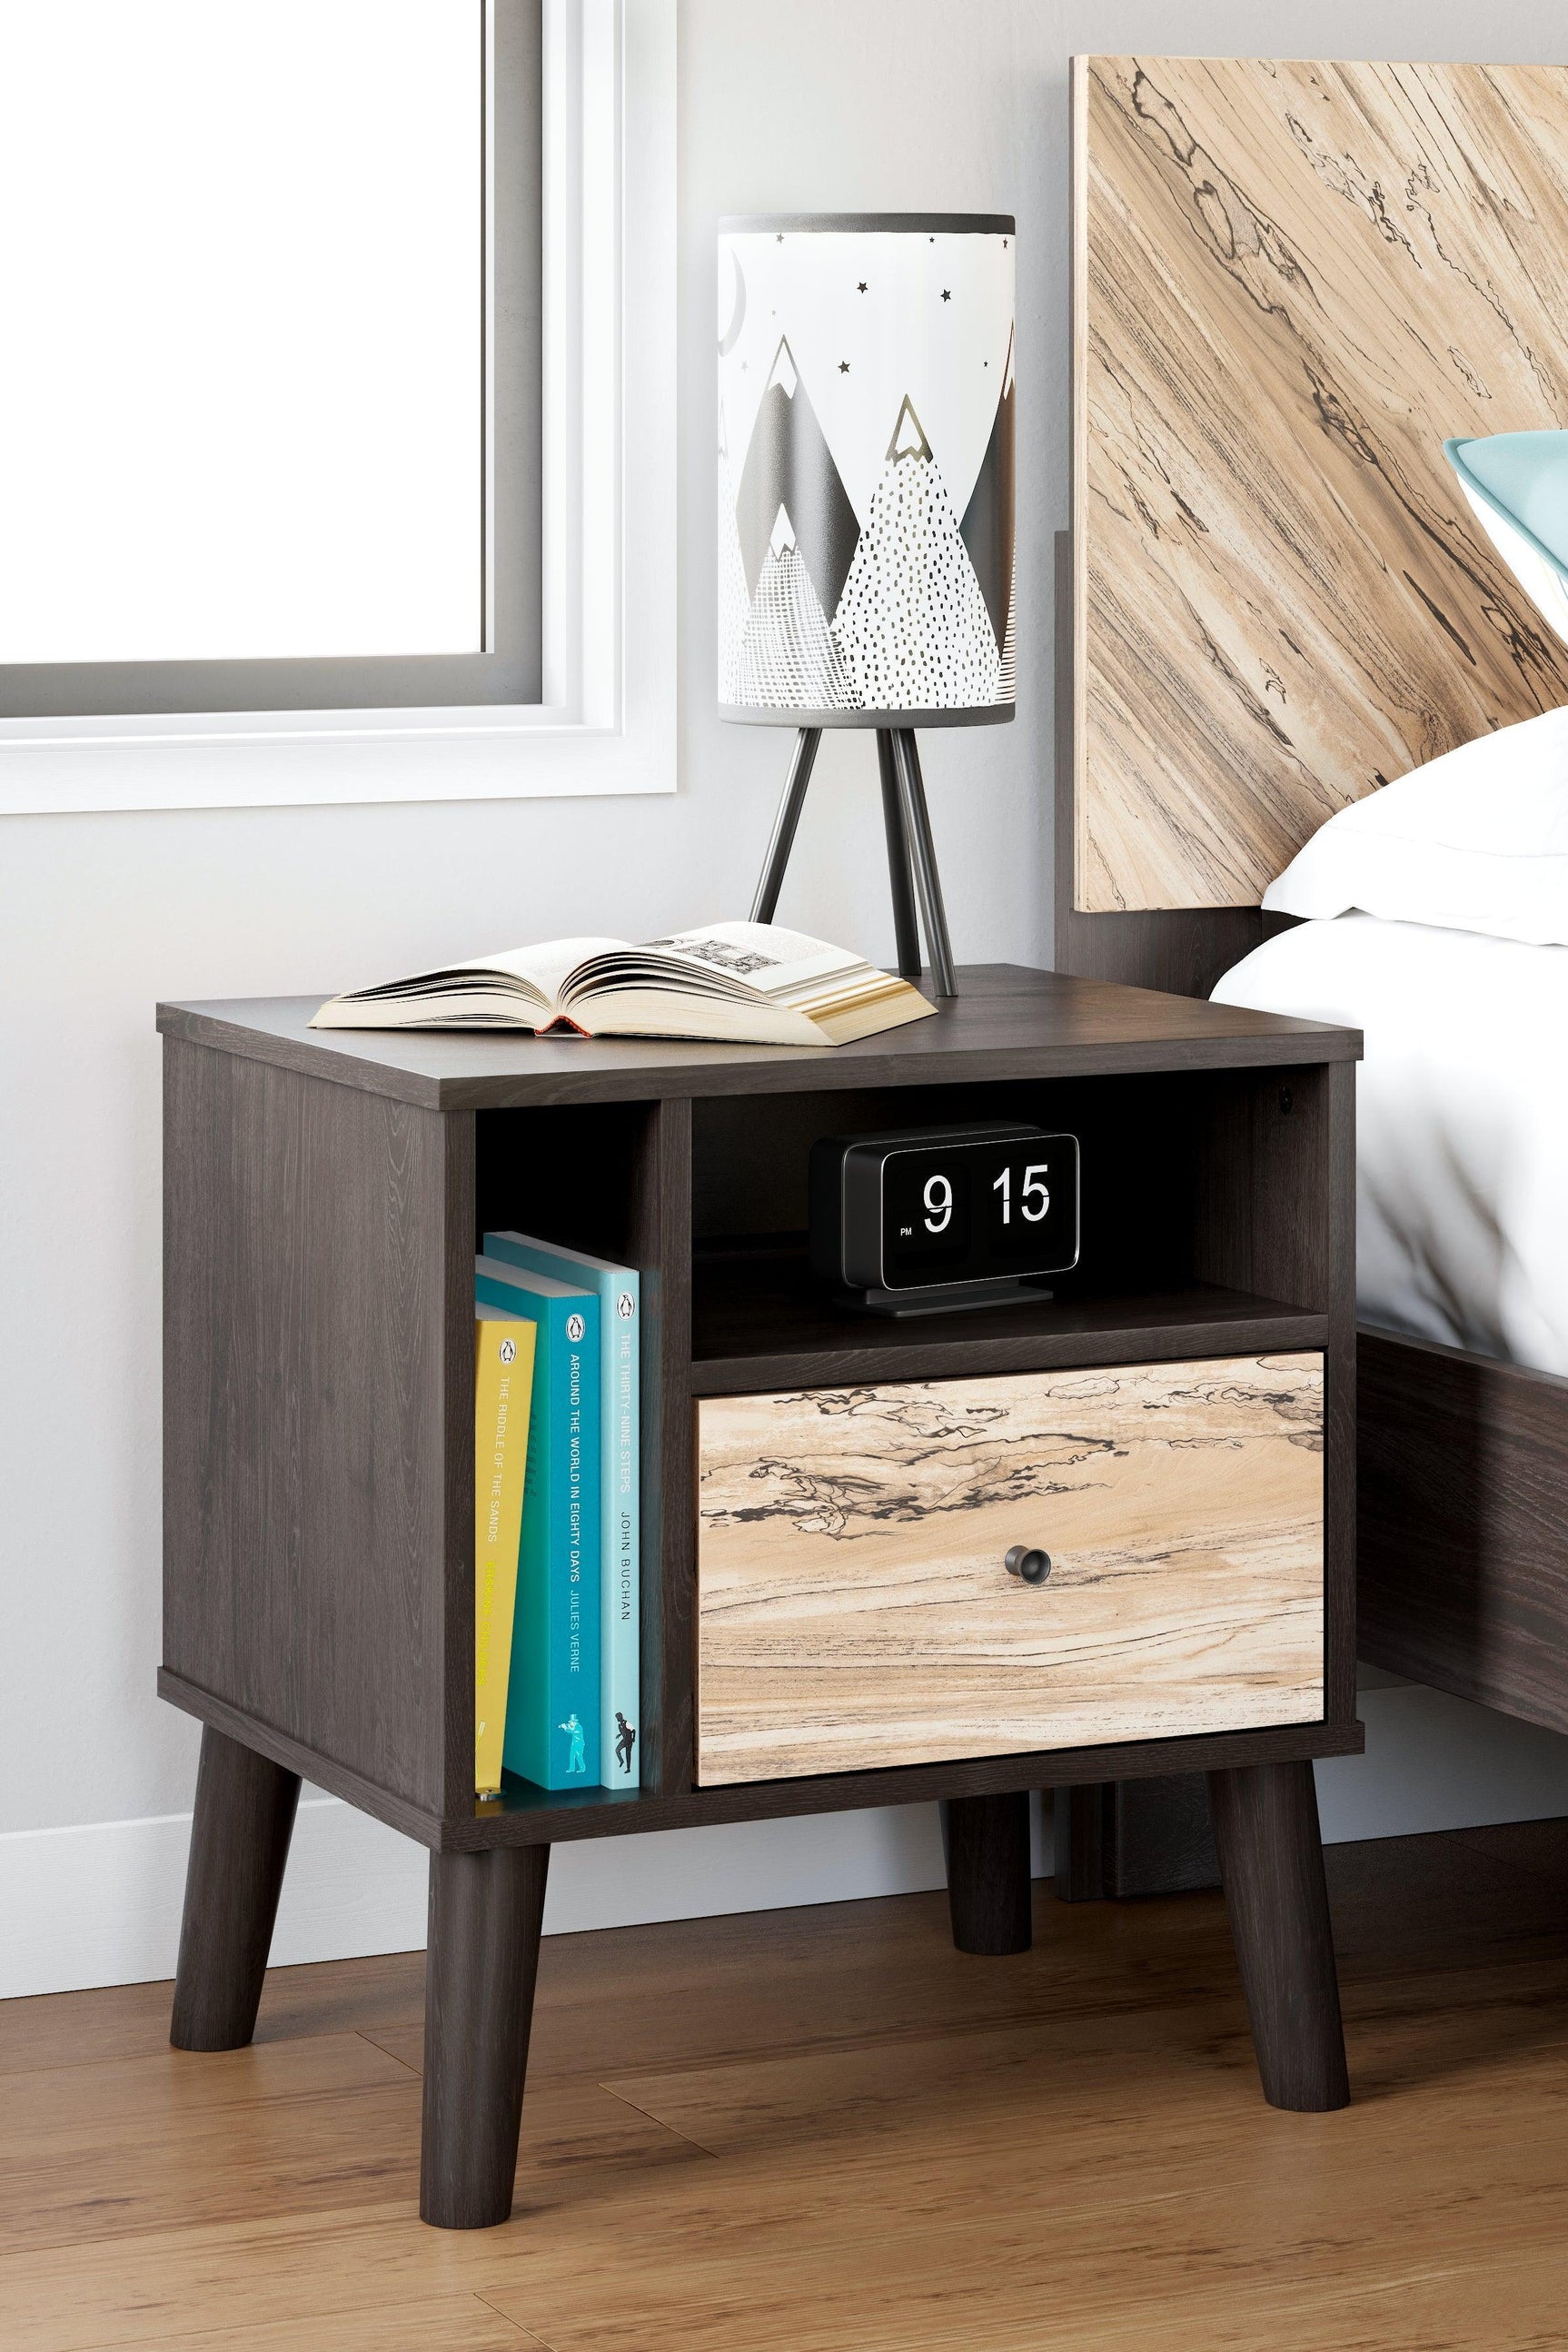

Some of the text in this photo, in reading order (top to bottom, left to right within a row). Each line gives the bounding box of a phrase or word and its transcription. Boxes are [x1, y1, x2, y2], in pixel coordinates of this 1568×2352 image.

[899, 1227, 912, 1236] PM
[923, 1164, 1050, 1233] 9 15
[488, 1376, 510, 1543] THE RIDDLE OF THE SANDS
[571, 1354, 580, 1583] AROUND THE WORLD IN EIGHTY DAYS
[620, 1334, 630, 1493] THE THIRTY-NINE STEPS
[477, 1561, 495, 1686] ERSKINE CHILDERS
[621, 1512, 630, 1621] JOHN BUCHAN
[571, 1590, 580, 1672] JULIES VERNE
